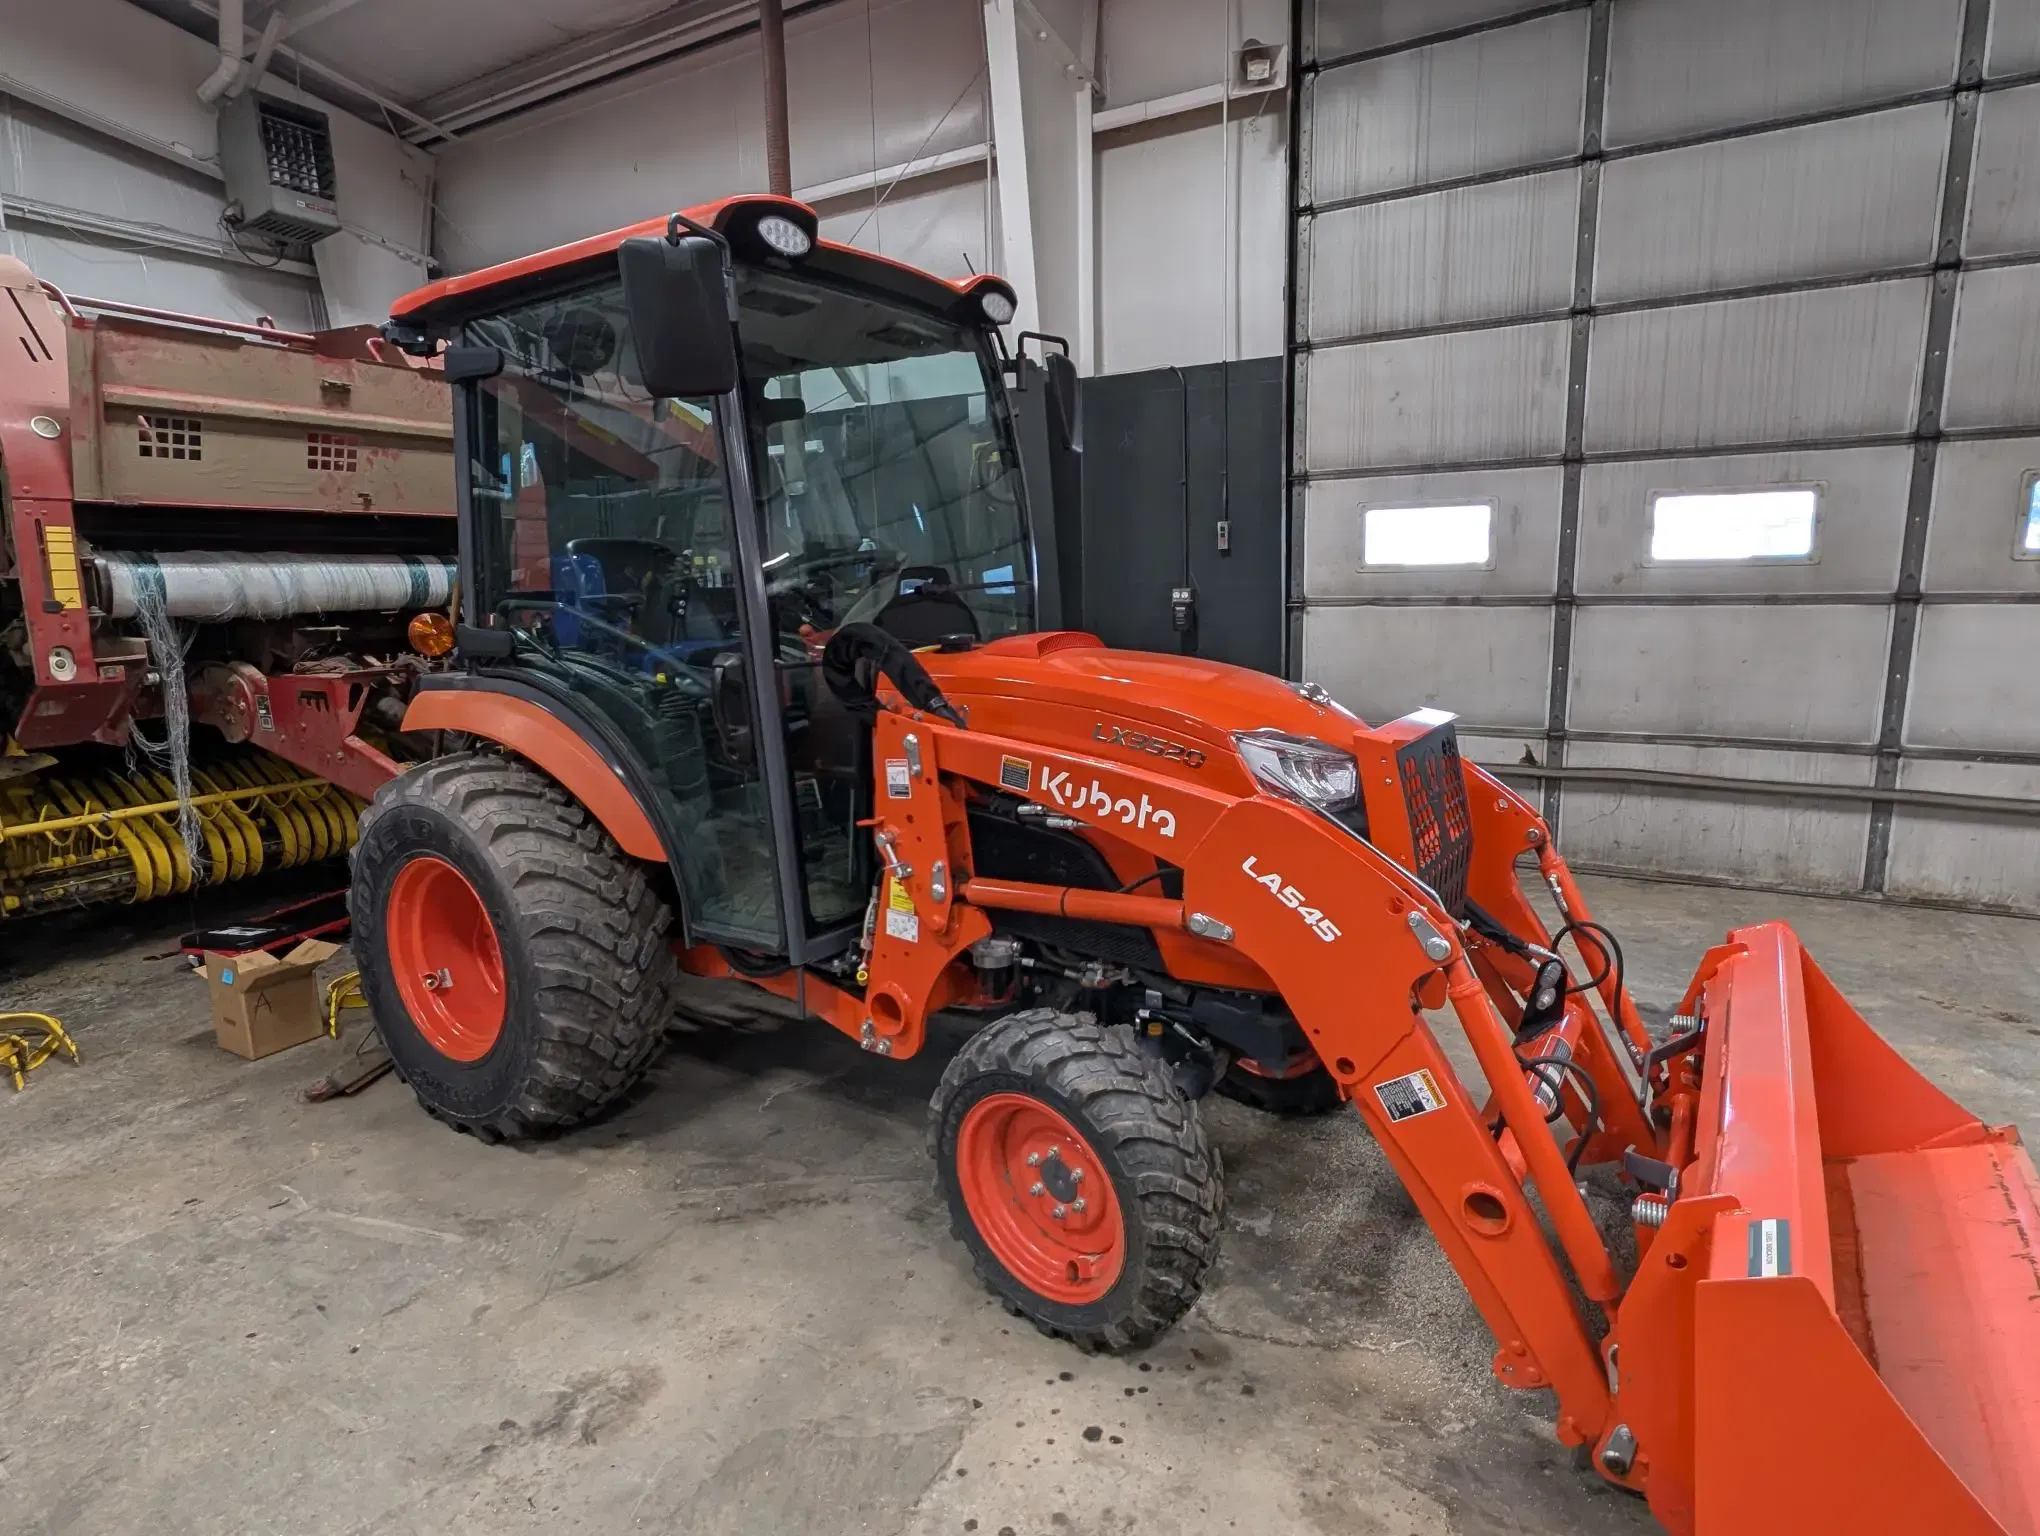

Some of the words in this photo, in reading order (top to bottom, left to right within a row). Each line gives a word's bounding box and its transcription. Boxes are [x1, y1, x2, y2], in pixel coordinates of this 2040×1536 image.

[1092, 723, 1206, 768] LX3520
[1041, 766, 1176, 837] Kubota
[1242, 856, 1342, 942] LA545
